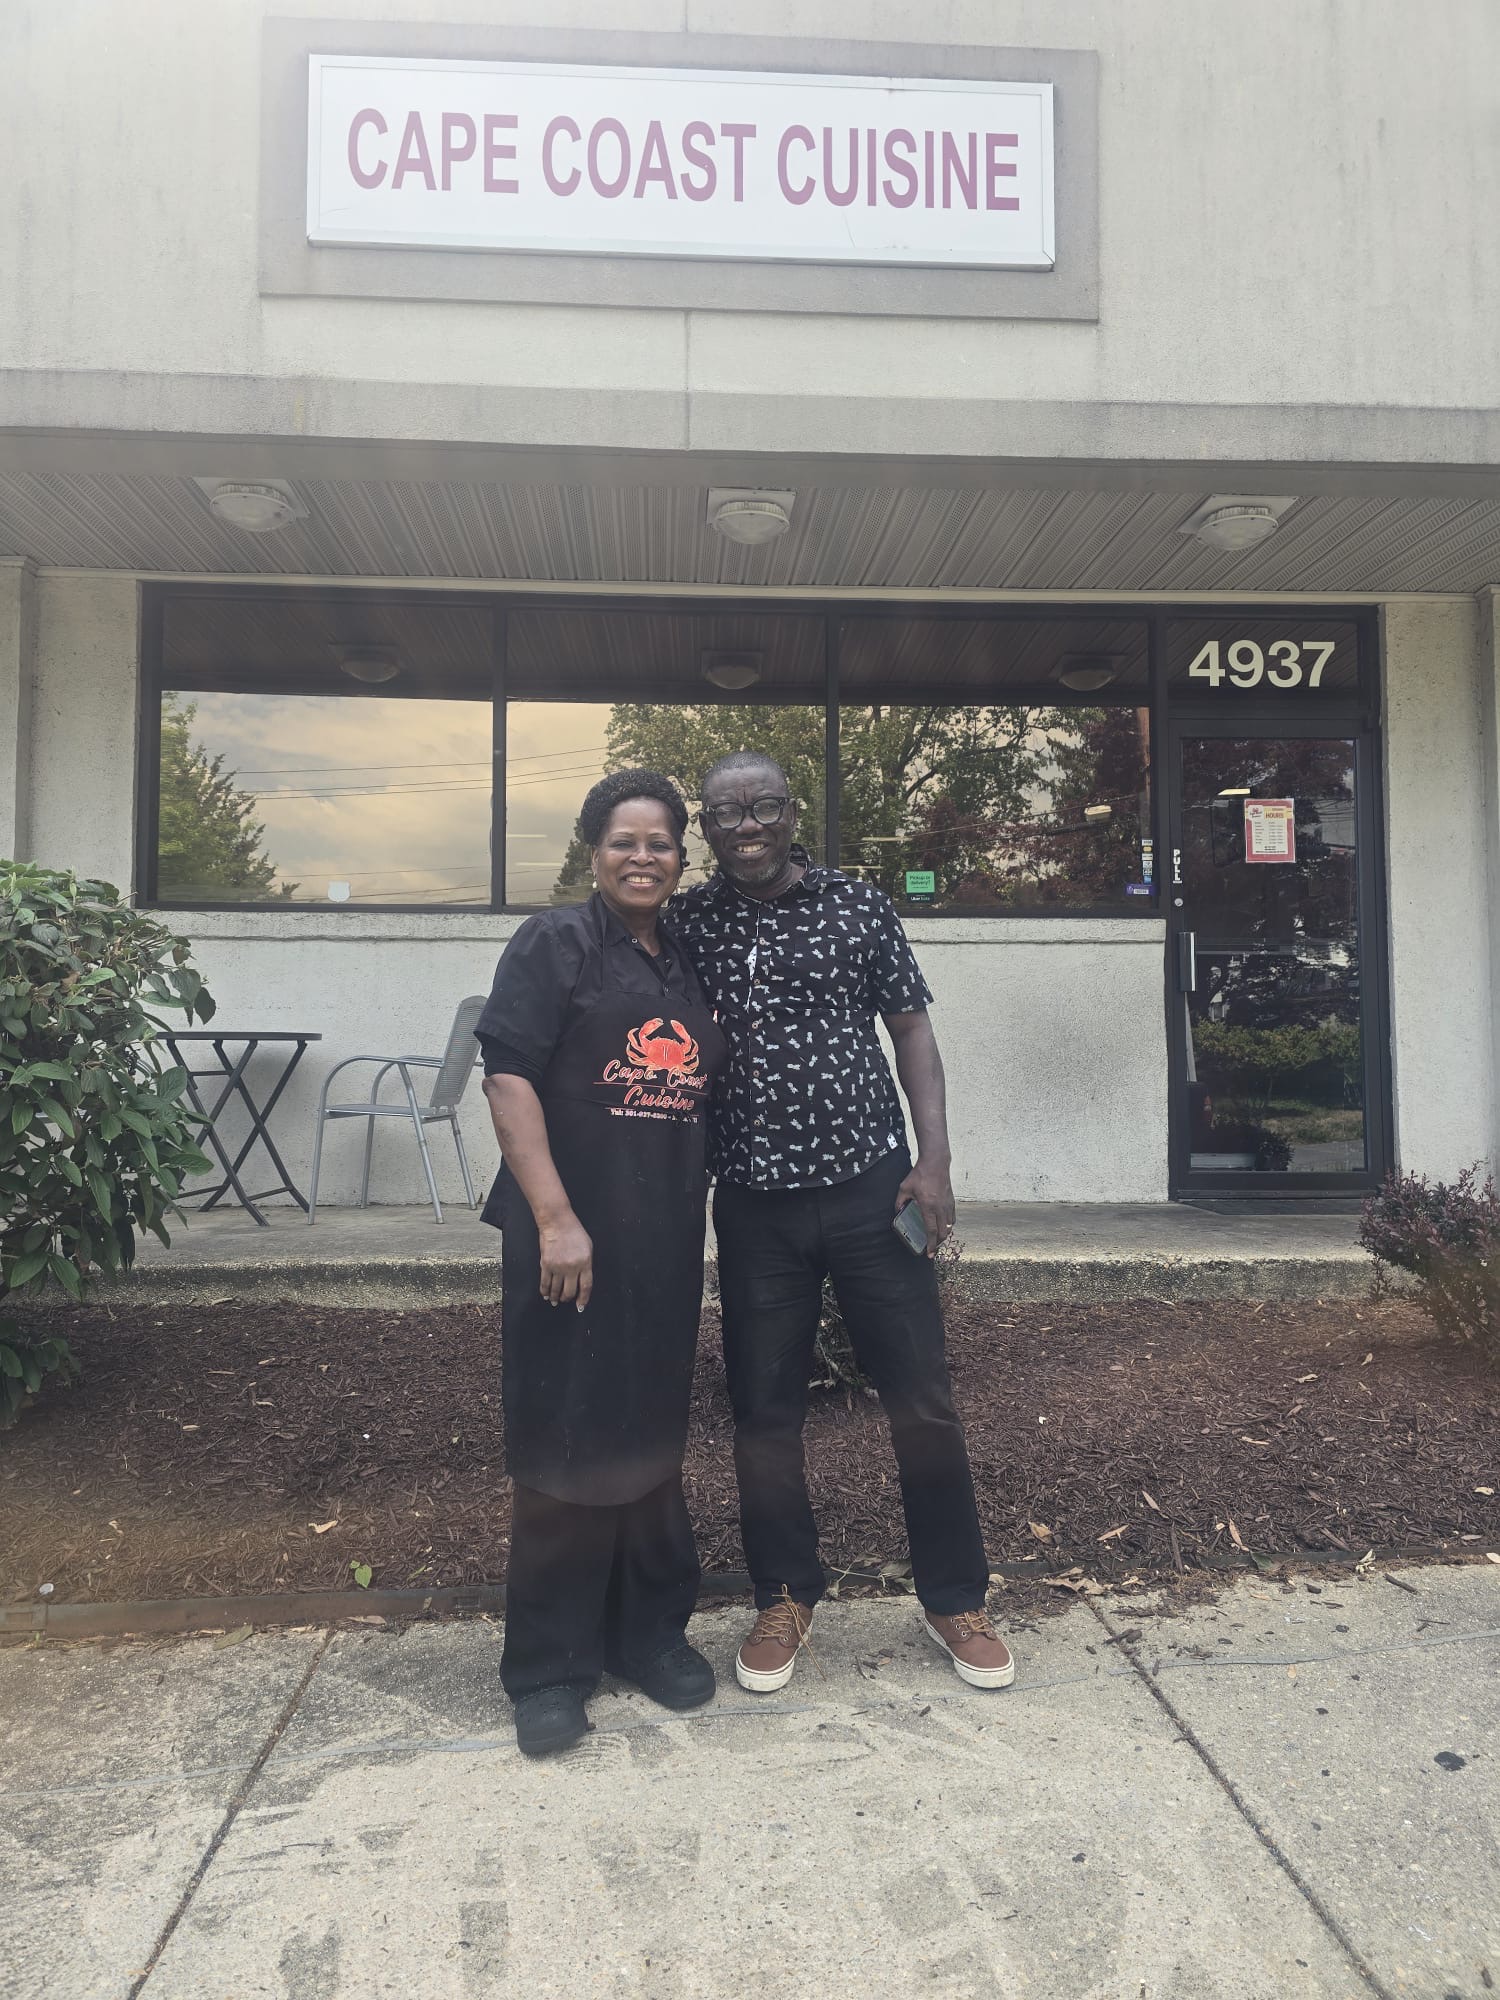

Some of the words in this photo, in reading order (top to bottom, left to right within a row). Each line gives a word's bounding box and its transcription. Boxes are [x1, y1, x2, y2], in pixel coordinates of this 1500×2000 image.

[347, 107, 519, 194] CAPE
[542, 115, 757, 203] COAST
[776, 123, 1021, 212] CUISINE
[1188, 639, 1336, 688] 4937
[1173, 848, 1181, 881] PULL
